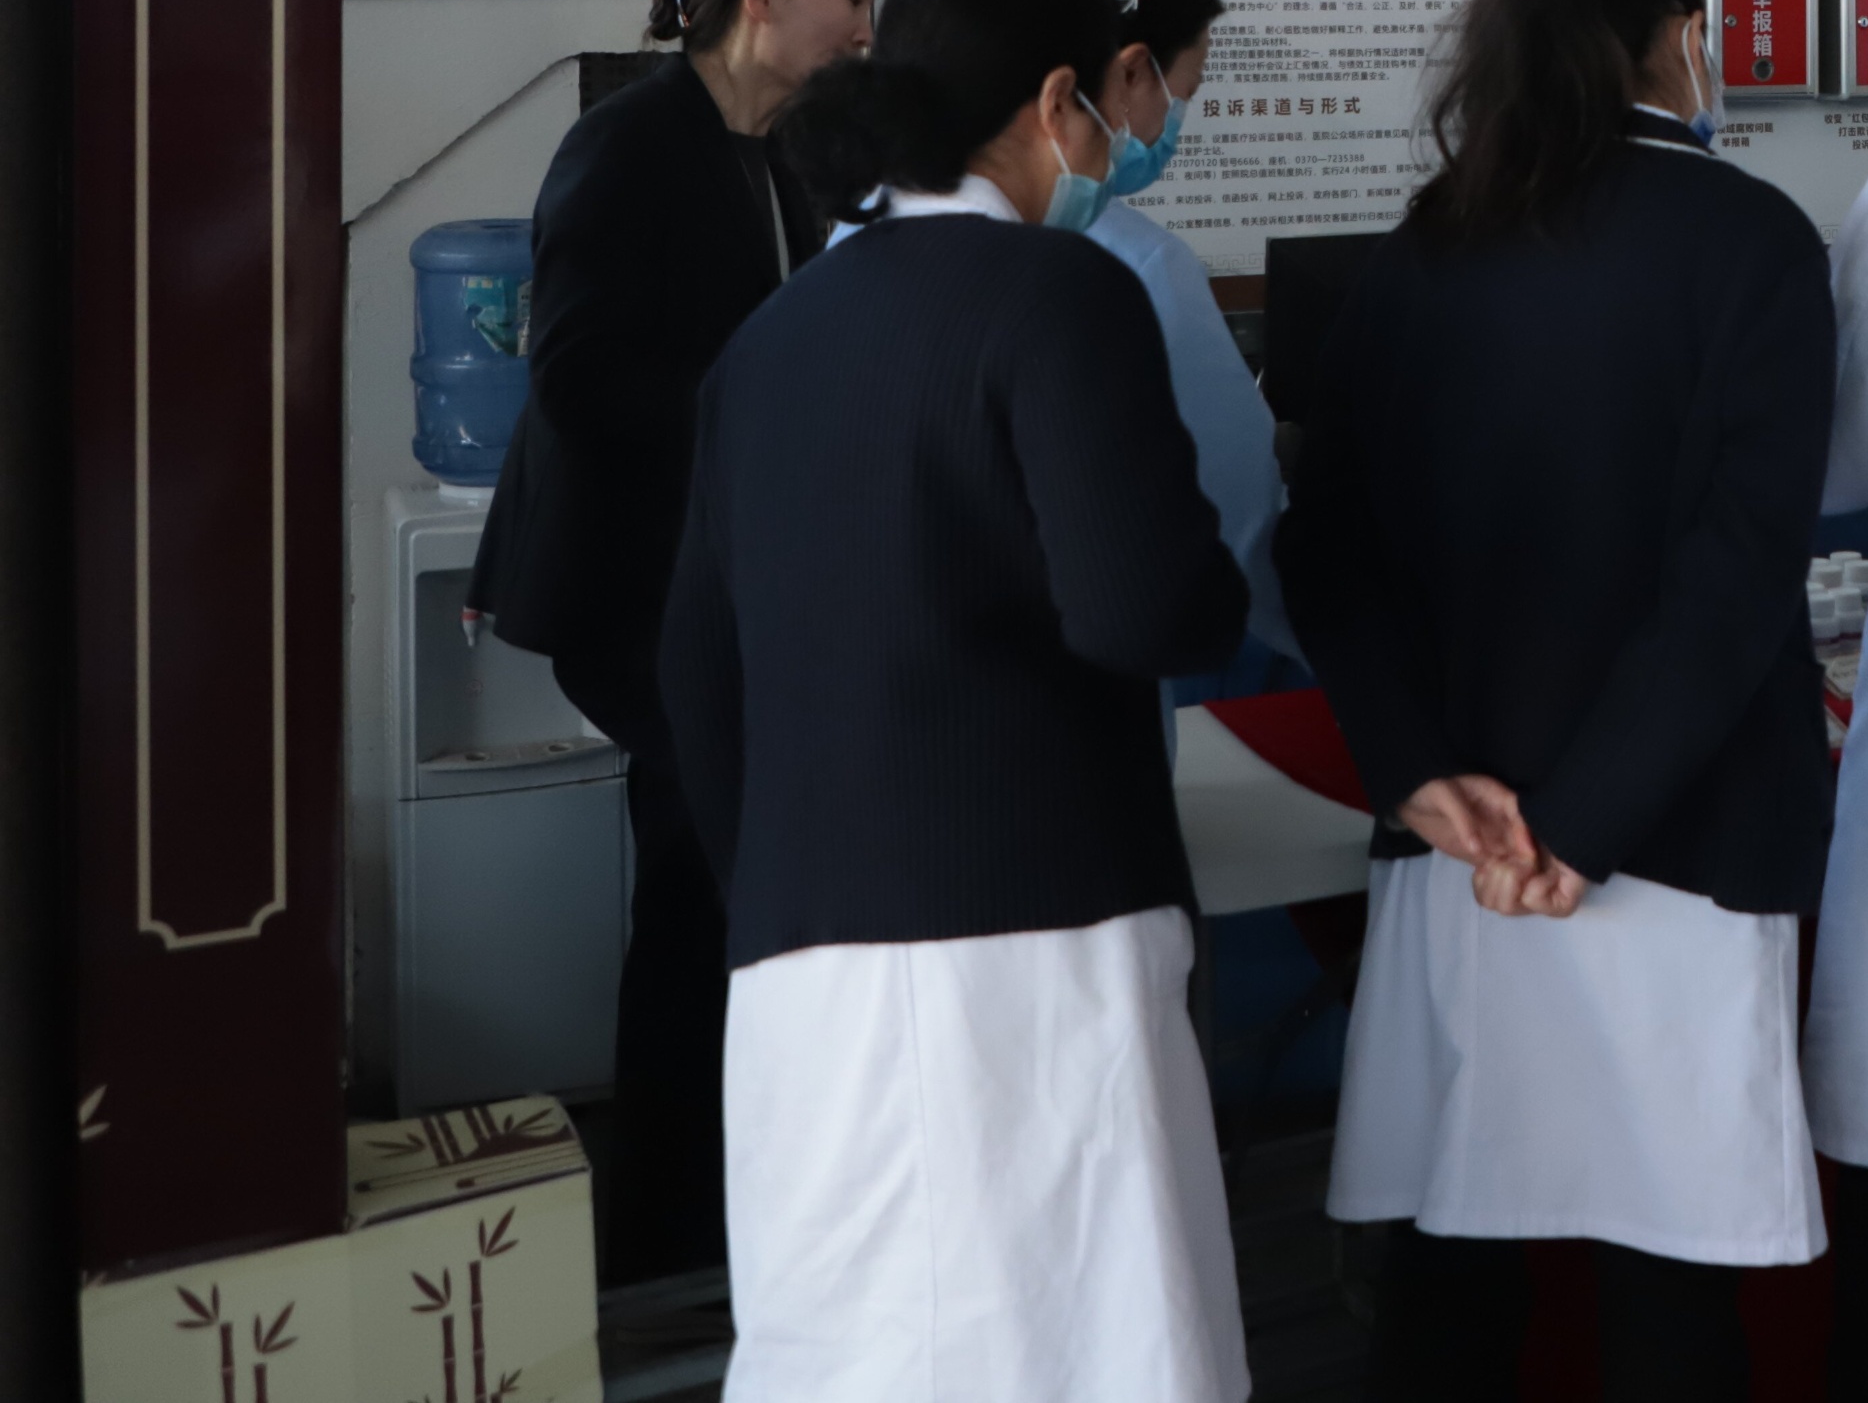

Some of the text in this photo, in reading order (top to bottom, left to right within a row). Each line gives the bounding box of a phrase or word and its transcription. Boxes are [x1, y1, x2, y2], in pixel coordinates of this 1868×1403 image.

[1203, 96, 1362, 117] 投诉渠道与形式
